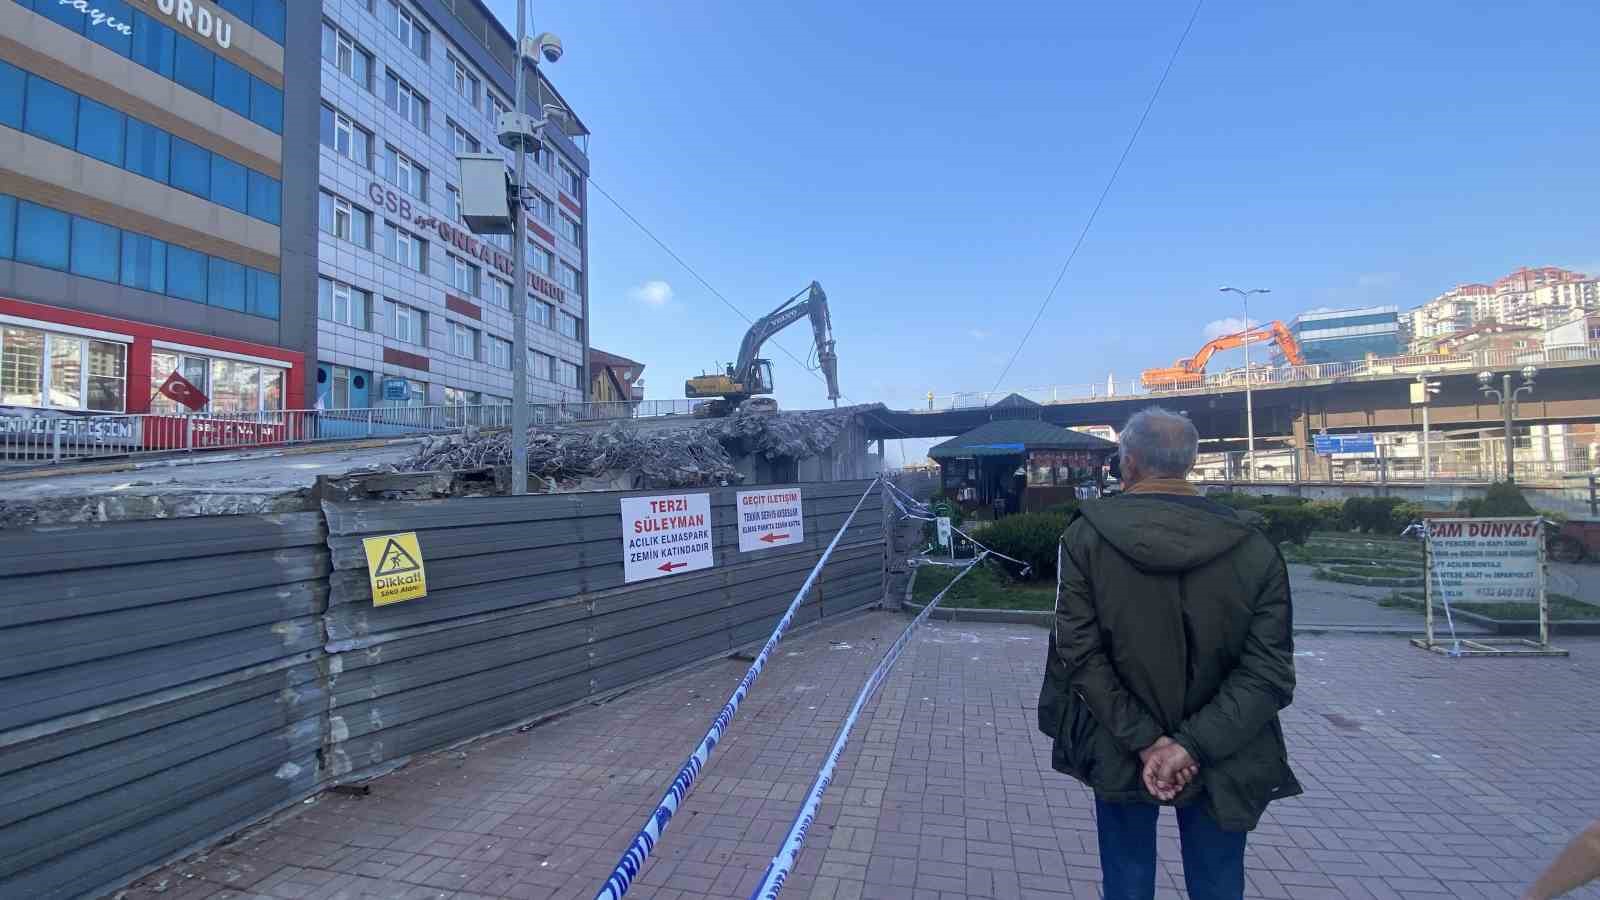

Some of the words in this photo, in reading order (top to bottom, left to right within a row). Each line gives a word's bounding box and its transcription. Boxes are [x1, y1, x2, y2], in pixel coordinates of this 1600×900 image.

[369, 182, 412, 221] GSB
[650, 496, 688, 514] TERZİ
[634, 514, 704, 534] SÜLEYMAN
[1430, 523, 1462, 538] CAM
[661, 530, 709, 545] ELMASPARK
[630, 551, 659, 563] ZEMİN
[661, 542, 709, 559] KATINDADIR
